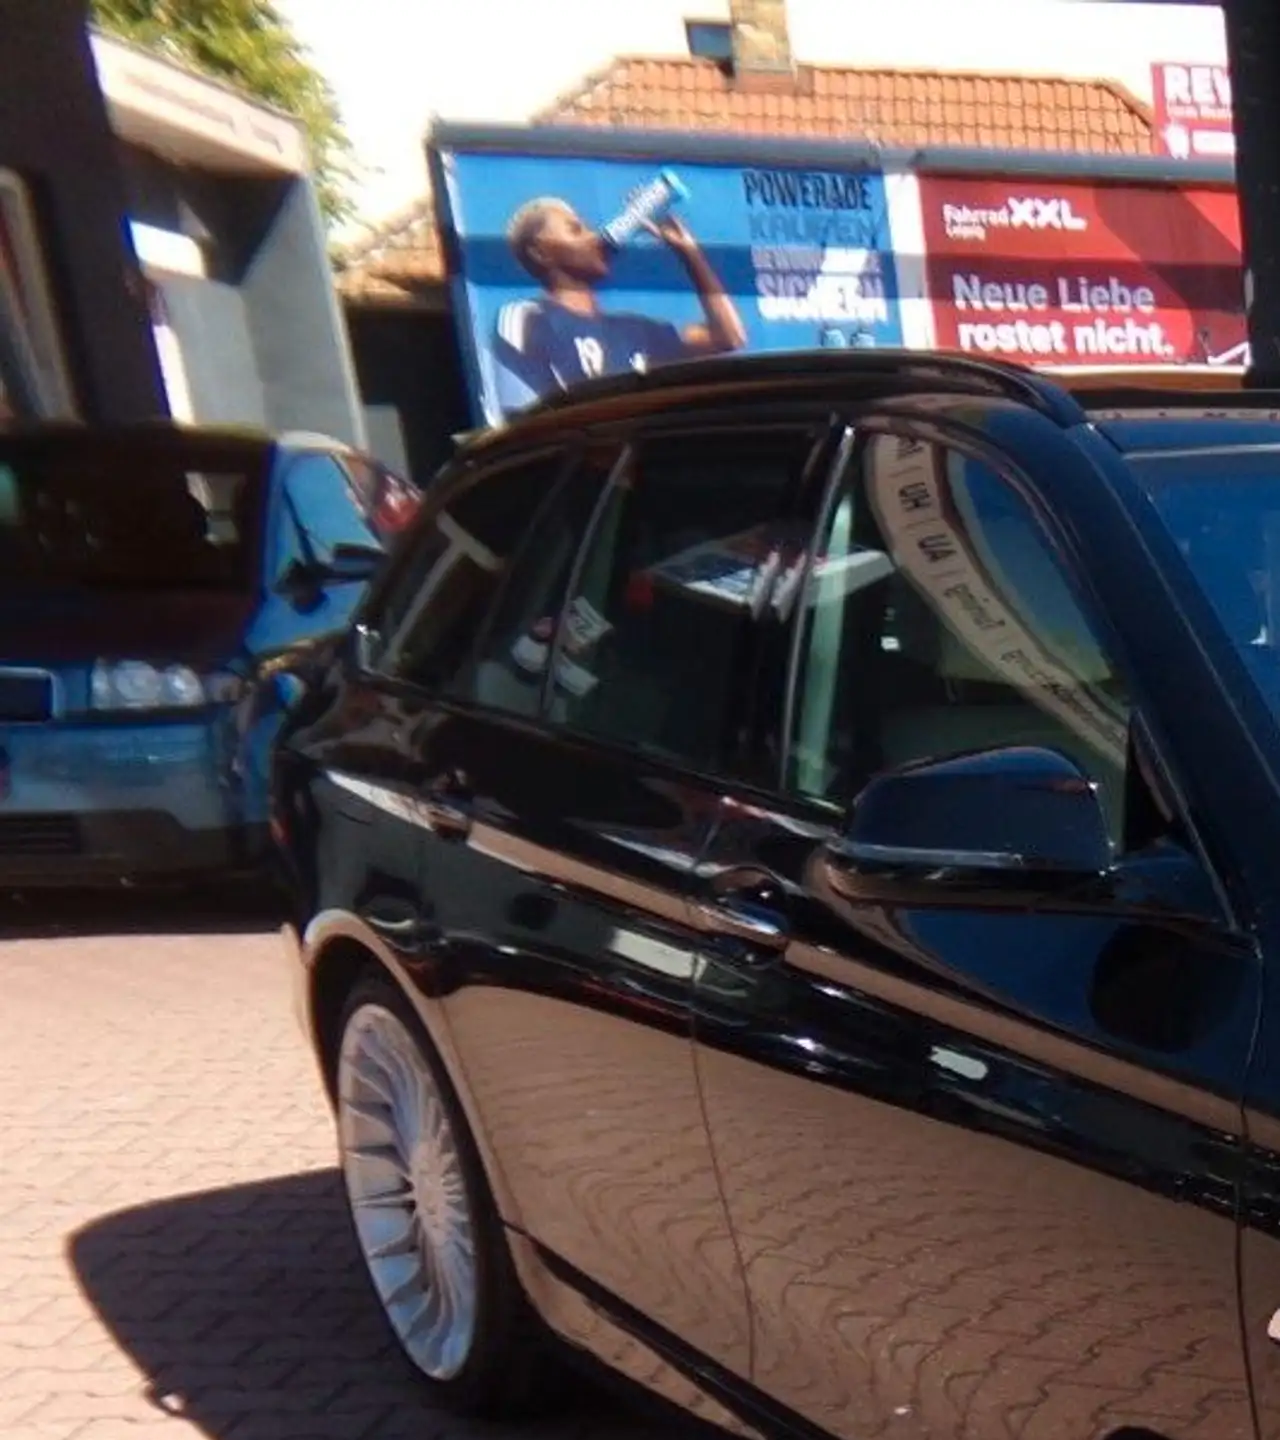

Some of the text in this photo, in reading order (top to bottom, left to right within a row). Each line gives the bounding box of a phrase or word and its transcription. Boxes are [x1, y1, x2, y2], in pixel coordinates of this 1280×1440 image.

[1007, 196, 1087, 231] XXL
[953, 273, 1154, 313] Neue Liebe
[958, 317, 1174, 355] rostet nicht.
